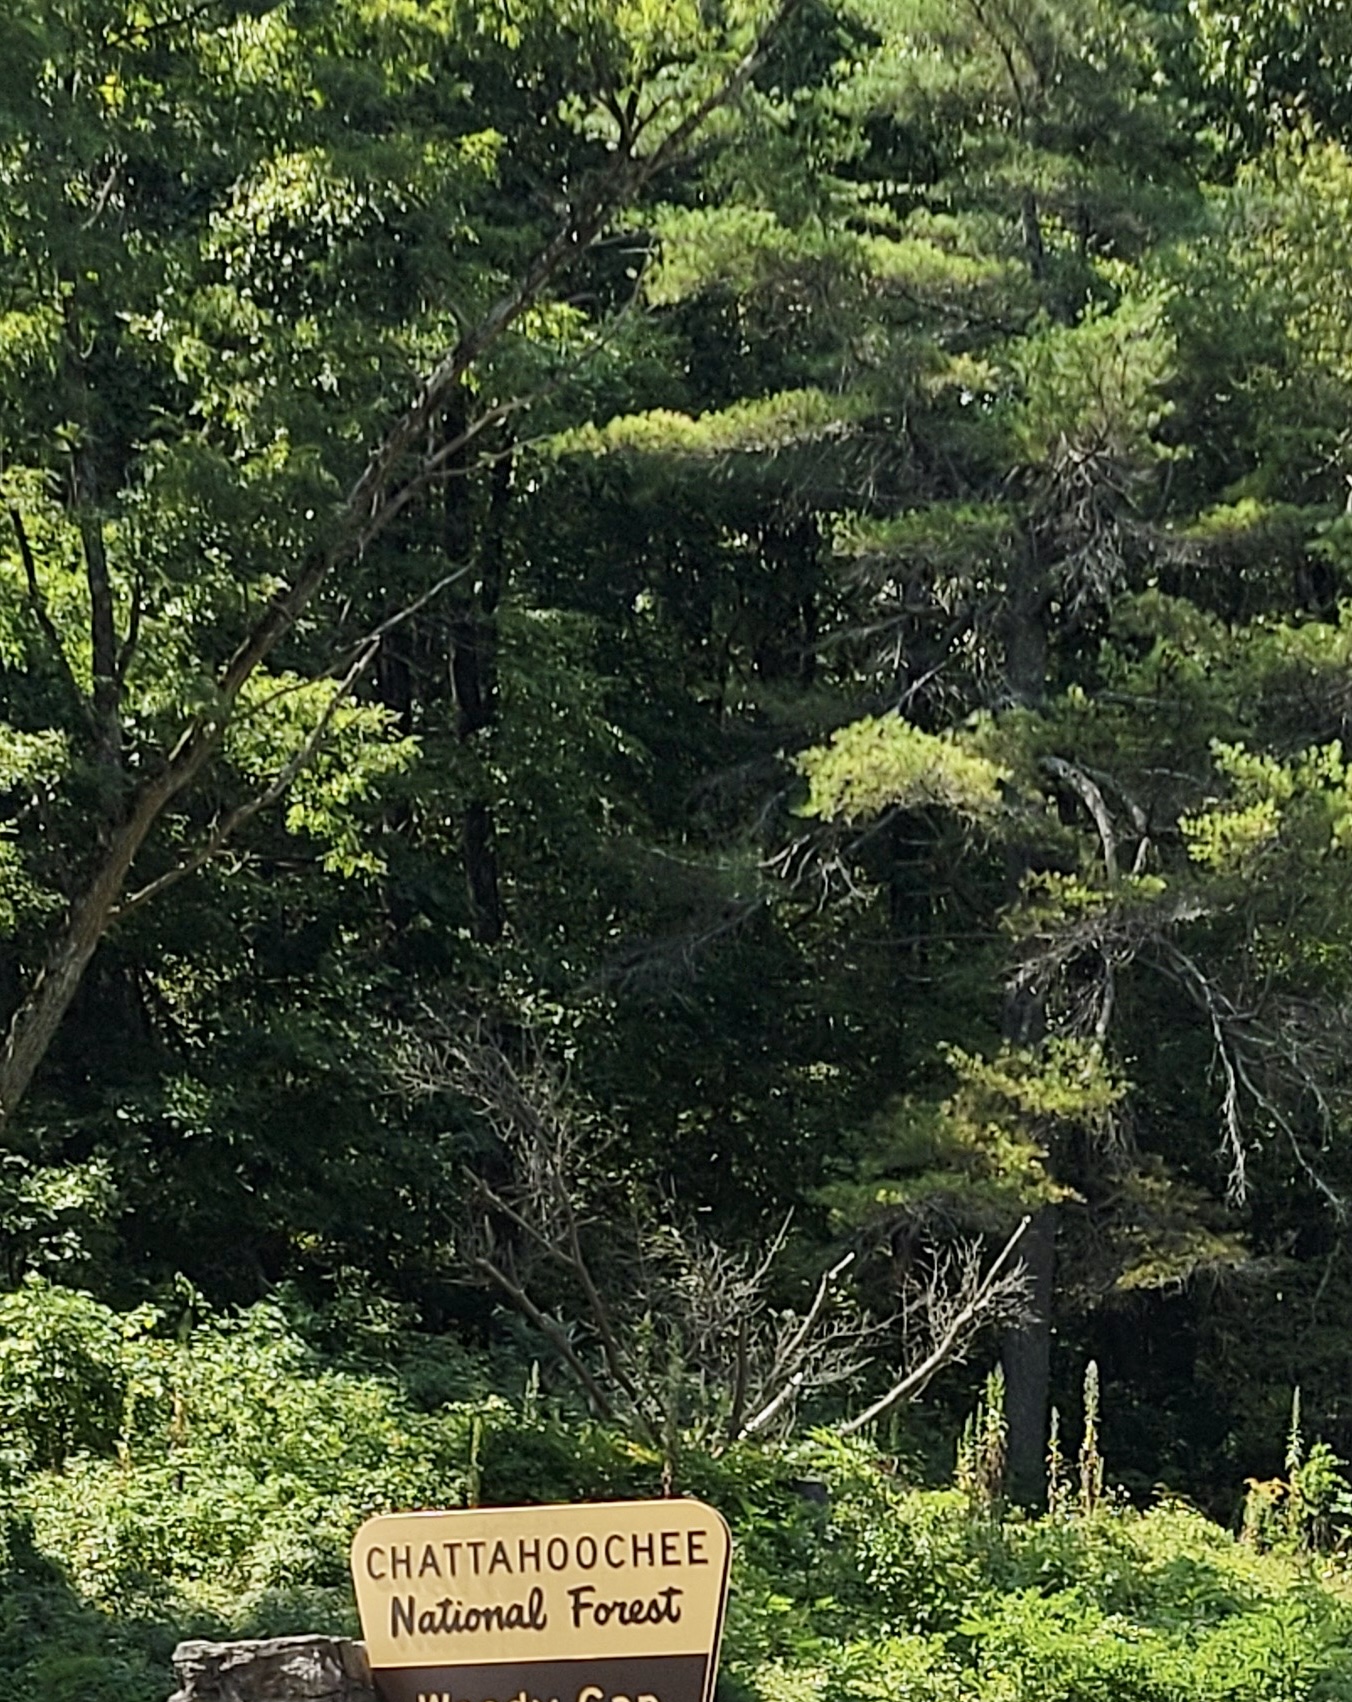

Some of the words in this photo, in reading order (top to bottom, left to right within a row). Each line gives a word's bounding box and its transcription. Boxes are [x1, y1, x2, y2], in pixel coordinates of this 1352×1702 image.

[366, 1530, 709, 1580] CHATTAHOOCHEE
[390, 1587, 547, 1638] National
[568, 1586, 683, 1629] Forest
